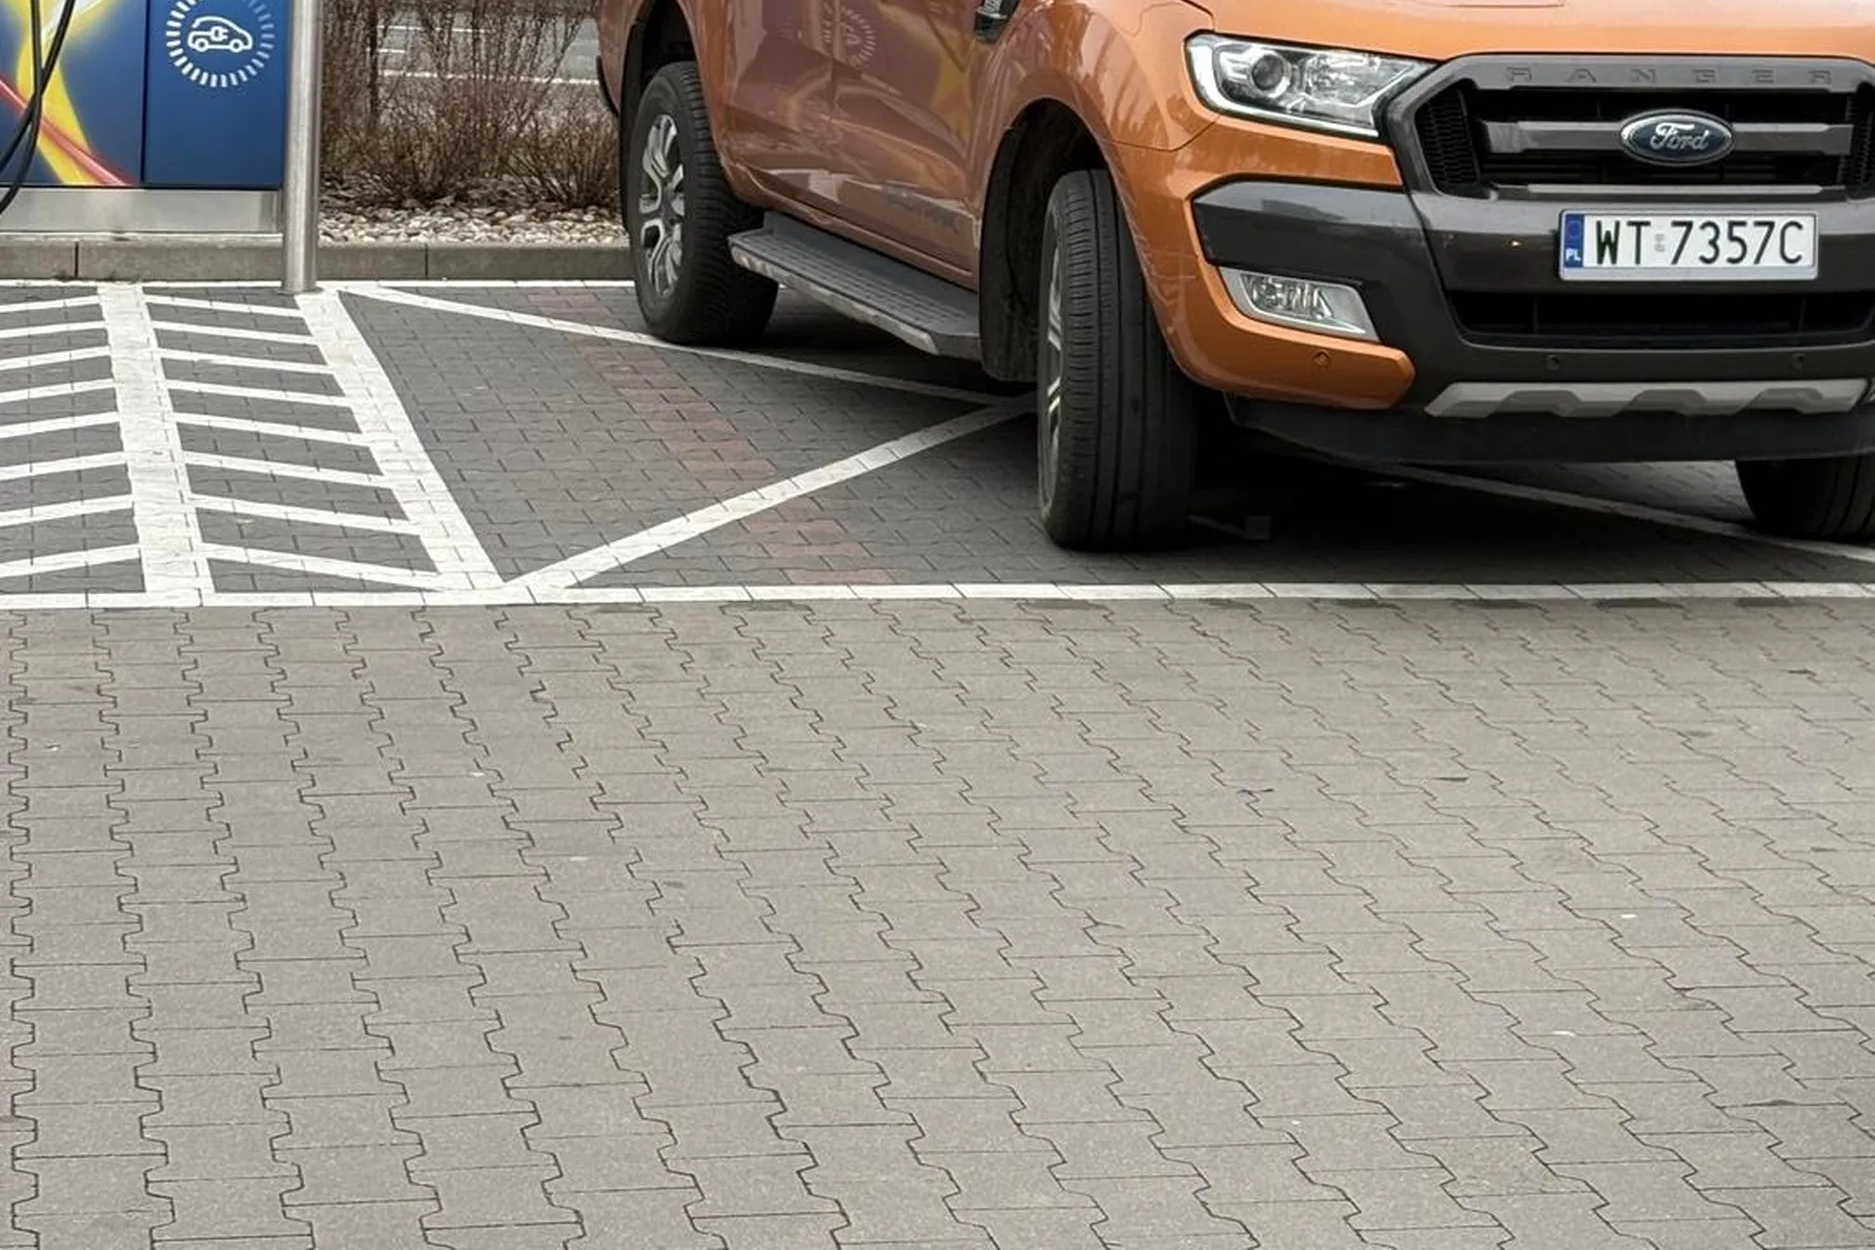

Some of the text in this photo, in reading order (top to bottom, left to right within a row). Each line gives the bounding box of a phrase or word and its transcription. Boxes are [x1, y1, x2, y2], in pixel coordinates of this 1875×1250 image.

[1507, 67, 1832, 84] RANGER
[1650, 122, 1709, 150] Ford
[1565, 220, 1804, 265] PL WT 7357C
